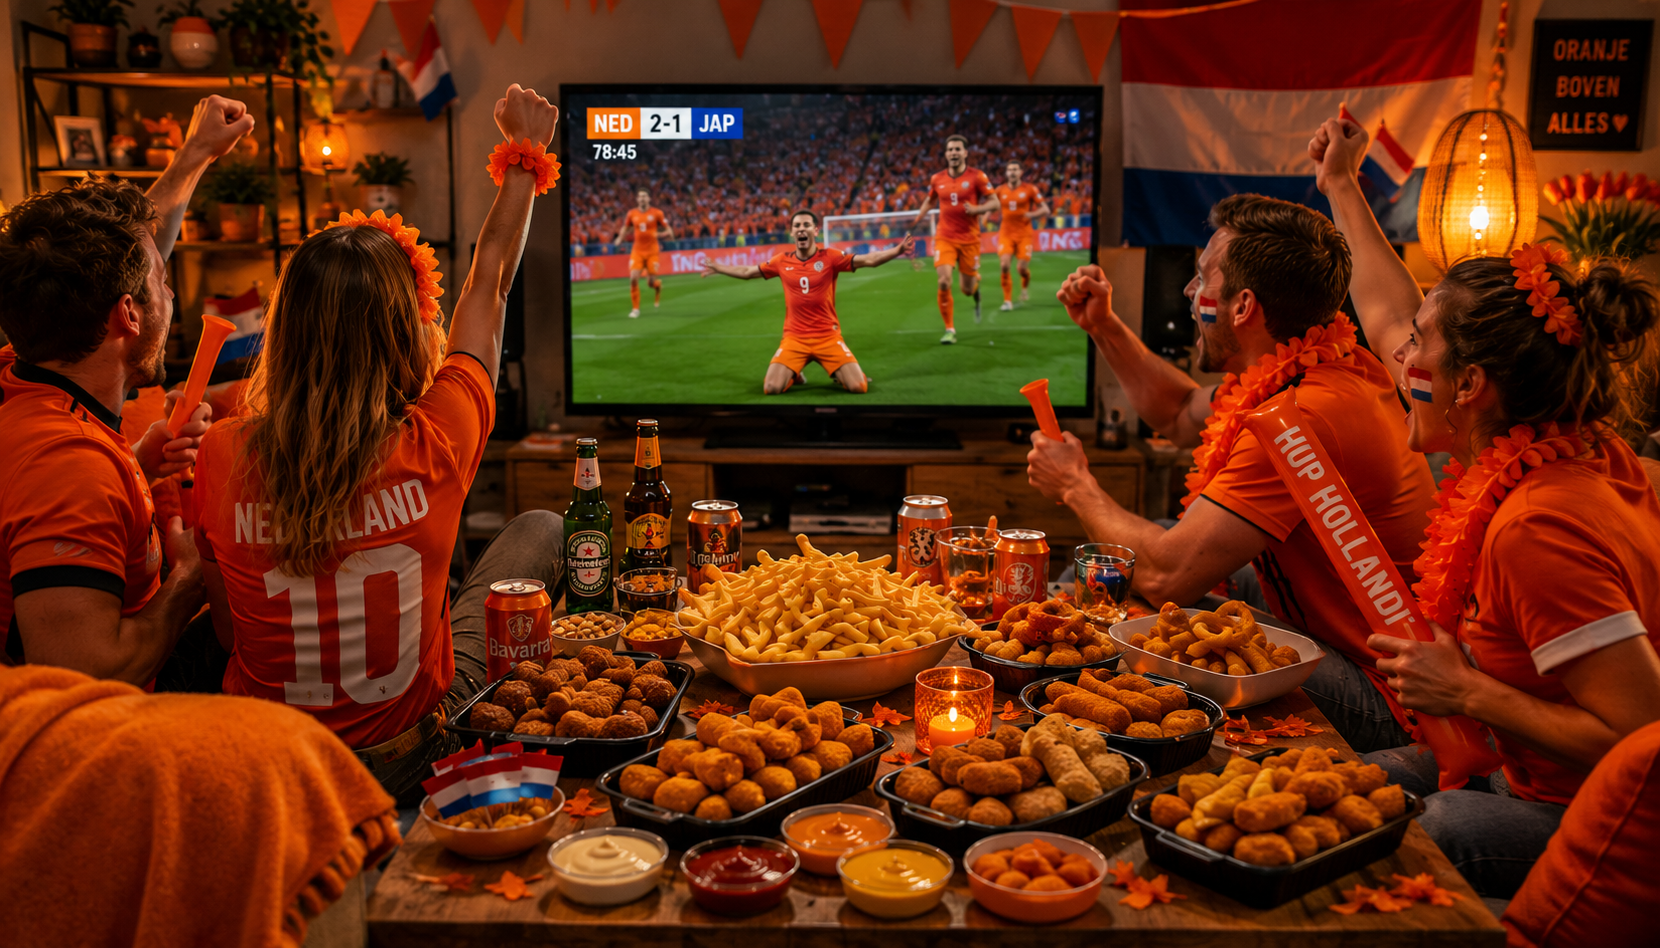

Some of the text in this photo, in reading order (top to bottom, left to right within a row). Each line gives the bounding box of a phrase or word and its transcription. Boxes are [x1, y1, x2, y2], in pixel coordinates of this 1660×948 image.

[1553, 38, 1630, 61] ORANJE
[1555, 75, 1621, 98] BOVEN
[594, 113, 735, 133] NED 2-1 JAP
[1546, 111, 1609, 134] ALLES
[592, 143, 637, 160] 78:45
[798, 275, 811, 295] 9
[1274, 425, 1325, 481] HUP
[235, 479, 429, 544] NERLAND
[263, 543, 423, 706] 10
